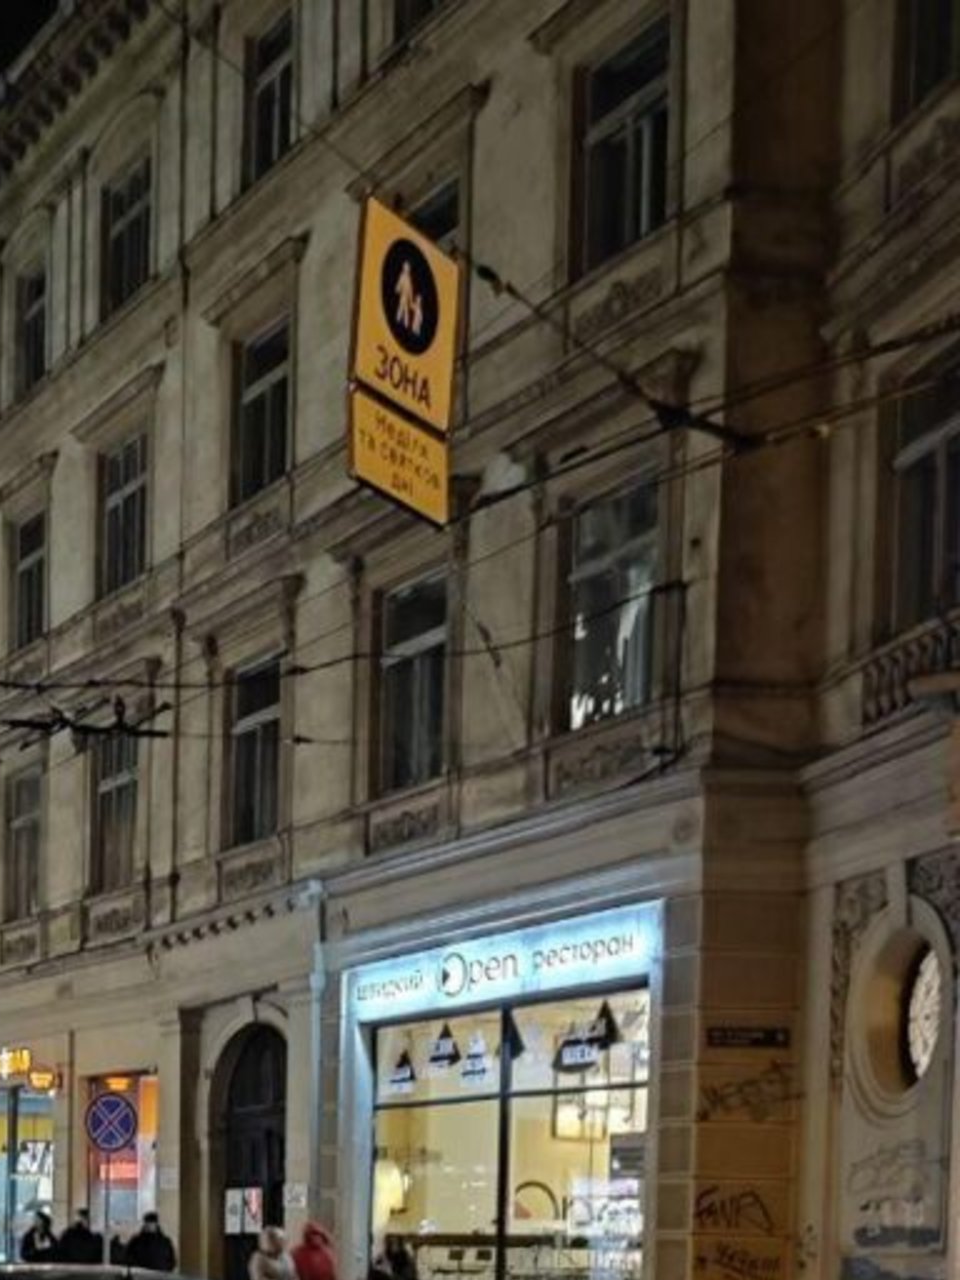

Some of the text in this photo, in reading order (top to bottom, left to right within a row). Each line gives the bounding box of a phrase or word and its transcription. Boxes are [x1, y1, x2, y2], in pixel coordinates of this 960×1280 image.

[374, 345, 431, 407] ЗОНА
[436, 952, 520, 998] Open
[533, 932, 635, 969] ресторан
